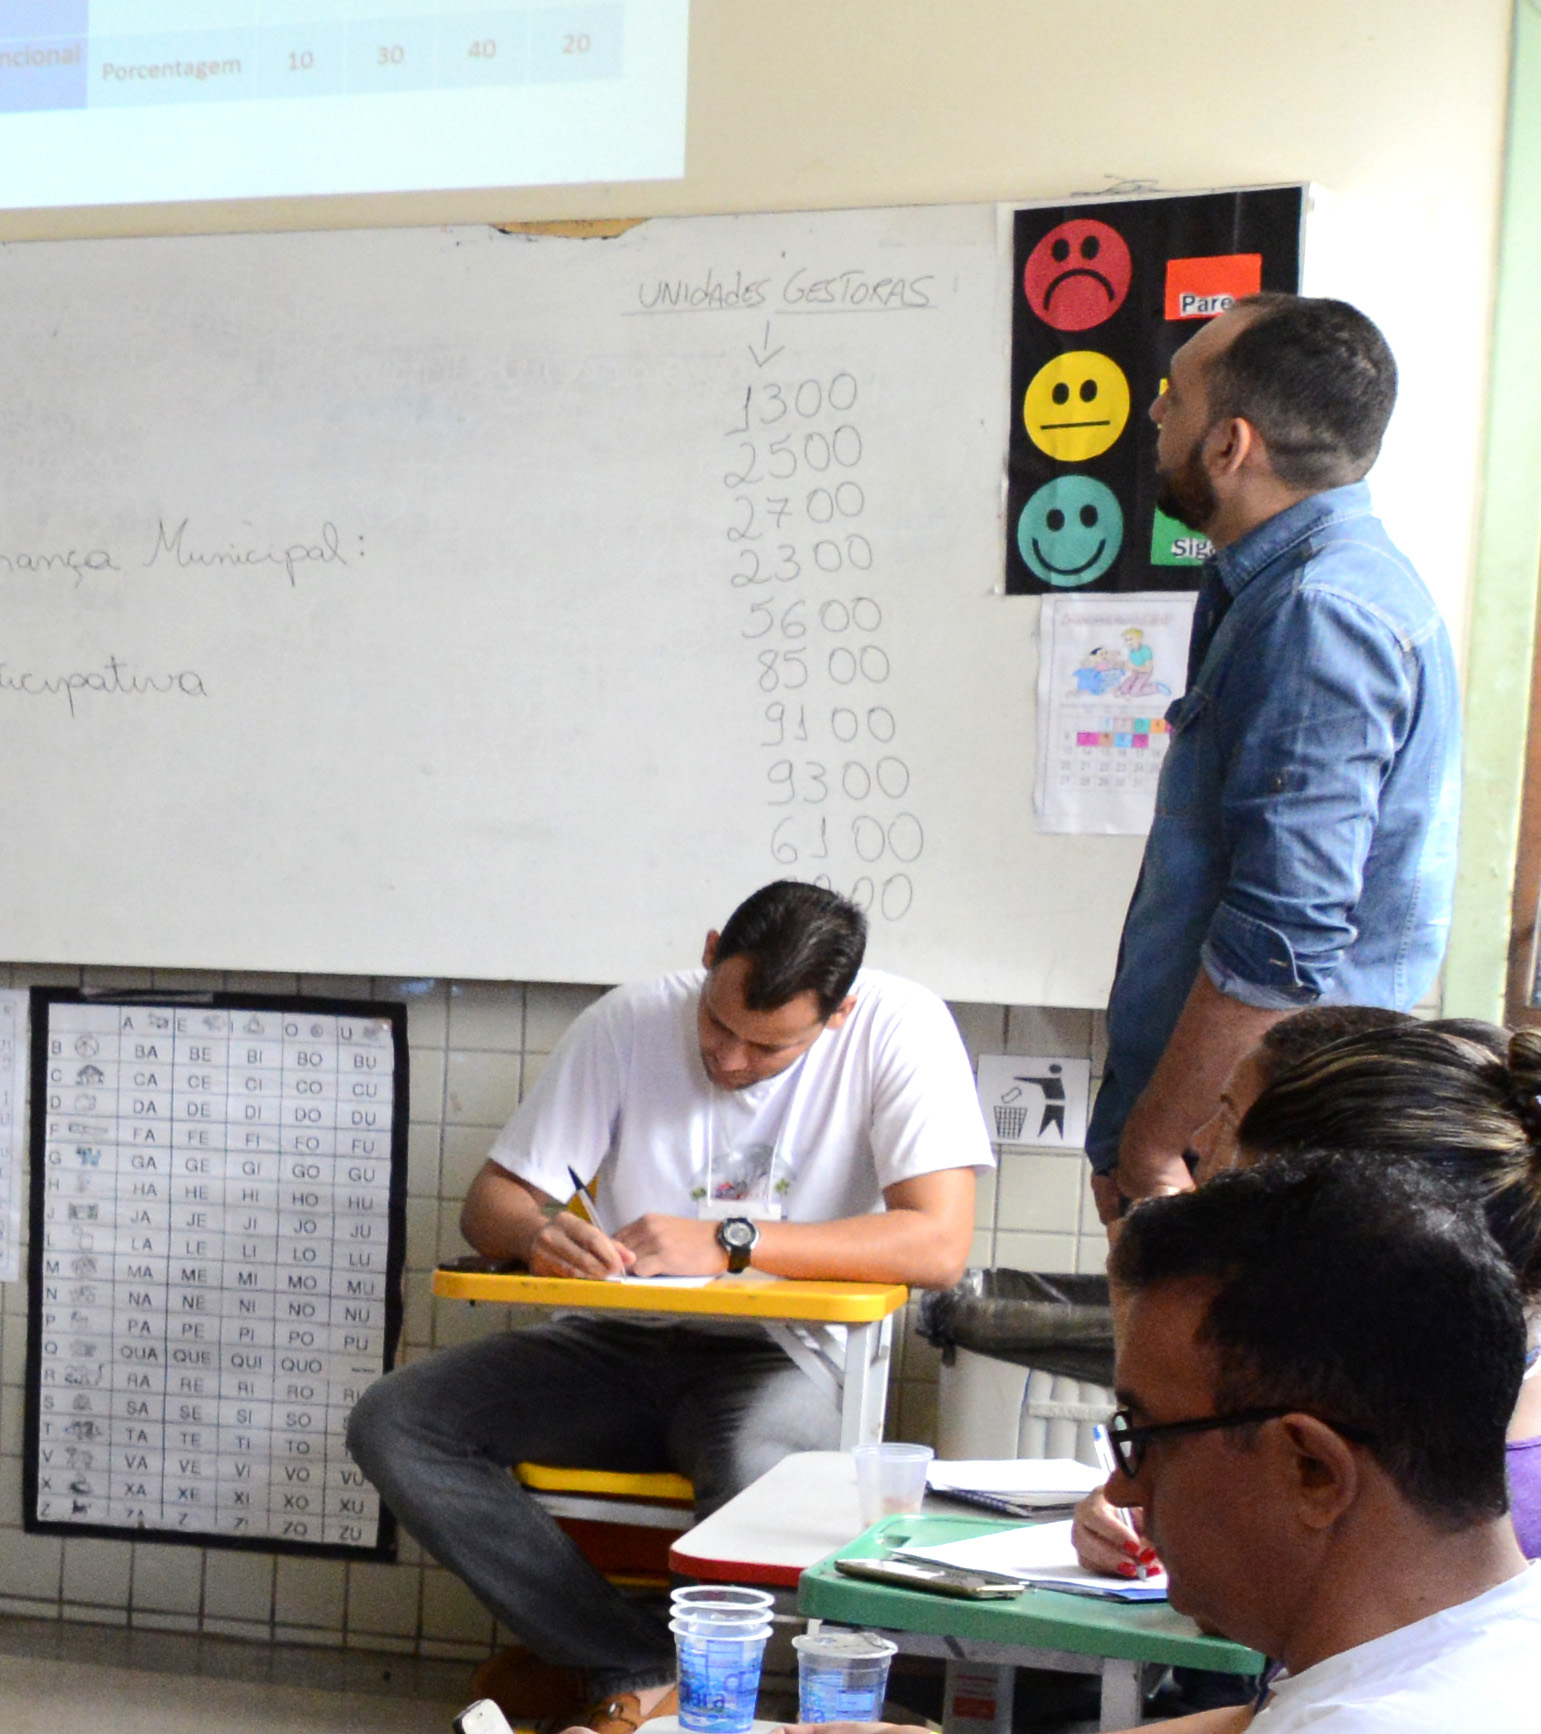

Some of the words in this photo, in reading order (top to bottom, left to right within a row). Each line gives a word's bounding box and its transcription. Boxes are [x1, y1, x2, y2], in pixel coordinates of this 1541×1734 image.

[287, 51, 315, 71] 10
[376, 45, 405, 65] 30
[467, 39, 497, 60] 40
[561, 33, 592, 54] 20
[101, 54, 243, 82] Porcentagem
[782, 268, 935, 308] GESTORAS
[1182, 294, 1234, 314] Pare
[724, 372, 858, 436] 1300
[723, 424, 863, 488] 2500
[726, 481, 866, 542] 2700
[142, 518, 368, 587] Municipal:
[729, 534, 874, 587] 2300
[740, 595, 883, 639] 5600
[756, 645, 891, 692] 8500
[760, 701, 897, 746] 9100
[767, 755, 911, 806] 9300
[135, 1045, 157, 1058] BA
[189, 1047, 211, 1062] BE
[247, 1049, 262, 1064] BI
[298, 1052, 323, 1067] BO
[354, 1054, 376, 1069] BU
[134, 1073, 158, 1086] CA
[187, 1075, 210, 1089] CE
[245, 1077, 262, 1091] CI
[296, 1080, 322, 1094] CO
[352, 1083, 377, 1098] CU
[134, 1100, 157, 1114] DA
[187, 1102, 210, 1118] DE
[245, 1105, 261, 1120] DI
[295, 1108, 321, 1122] DO
[351, 1110, 376, 1126] DU
[134, 1129, 155, 1142] FA
[188, 1131, 209, 1145] FE
[246, 1133, 260, 1147] FI
[295, 1137, 320, 1150] FO
[352, 1139, 374, 1154] FU
[132, 1155, 156, 1169] GA
[185, 1158, 210, 1173] GE
[242, 1161, 260, 1176] GI
[293, 1164, 320, 1179] GO
[348, 1167, 375, 1182] GU
[133, 1184, 157, 1196] HA
[185, 1186, 208, 1200] HE
[242, 1189, 258, 1202] HI
[292, 1193, 318, 1206] HO
[349, 1196, 373, 1210] HU
[131, 1211, 150, 1224] JA
[187, 1213, 205, 1227] JE
[244, 1217, 257, 1230] JI
[294, 1220, 317, 1234] JO
[350, 1225, 371, 1238] JU
[132, 1238, 152, 1251] LA
[186, 1241, 205, 1254] LE
[242, 1245, 256, 1259] LI
[293, 1248, 316, 1262] LO
[349, 1253, 370, 1267] LU
[128, 1266, 153, 1279] MA
[181, 1269, 207, 1284] ME
[238, 1272, 257, 1285] MI
[288, 1275, 316, 1289] MO
[348, 1280, 374, 1294] MU
[129, 1292, 152, 1306] NA
[183, 1295, 204, 1310] NE
[240, 1299, 255, 1313] NI
[289, 1303, 315, 1317] NO
[345, 1307, 369, 1322] NU
[128, 1320, 152, 1334] PA
[182, 1323, 204, 1338] PE
[239, 1327, 254, 1341] PI
[289, 1331, 314, 1346] PO
[344, 1335, 368, 1351] PU
[121, 1346, 158, 1360] QUA
[173, 1349, 210, 1364] QUE
[231, 1353, 261, 1369] QUI
[281, 1358, 322, 1373] QUO
[128, 1374, 150, 1388] RA
[181, 1378, 203, 1393] RE
[238, 1381, 253, 1395] RI
[287, 1385, 313, 1400] RO
[125, 1455, 148, 1470] VA
[179, 1460, 200, 1475] VE
[235, 1464, 250, 1478] VI
[285, 1467, 309, 1482] VO
